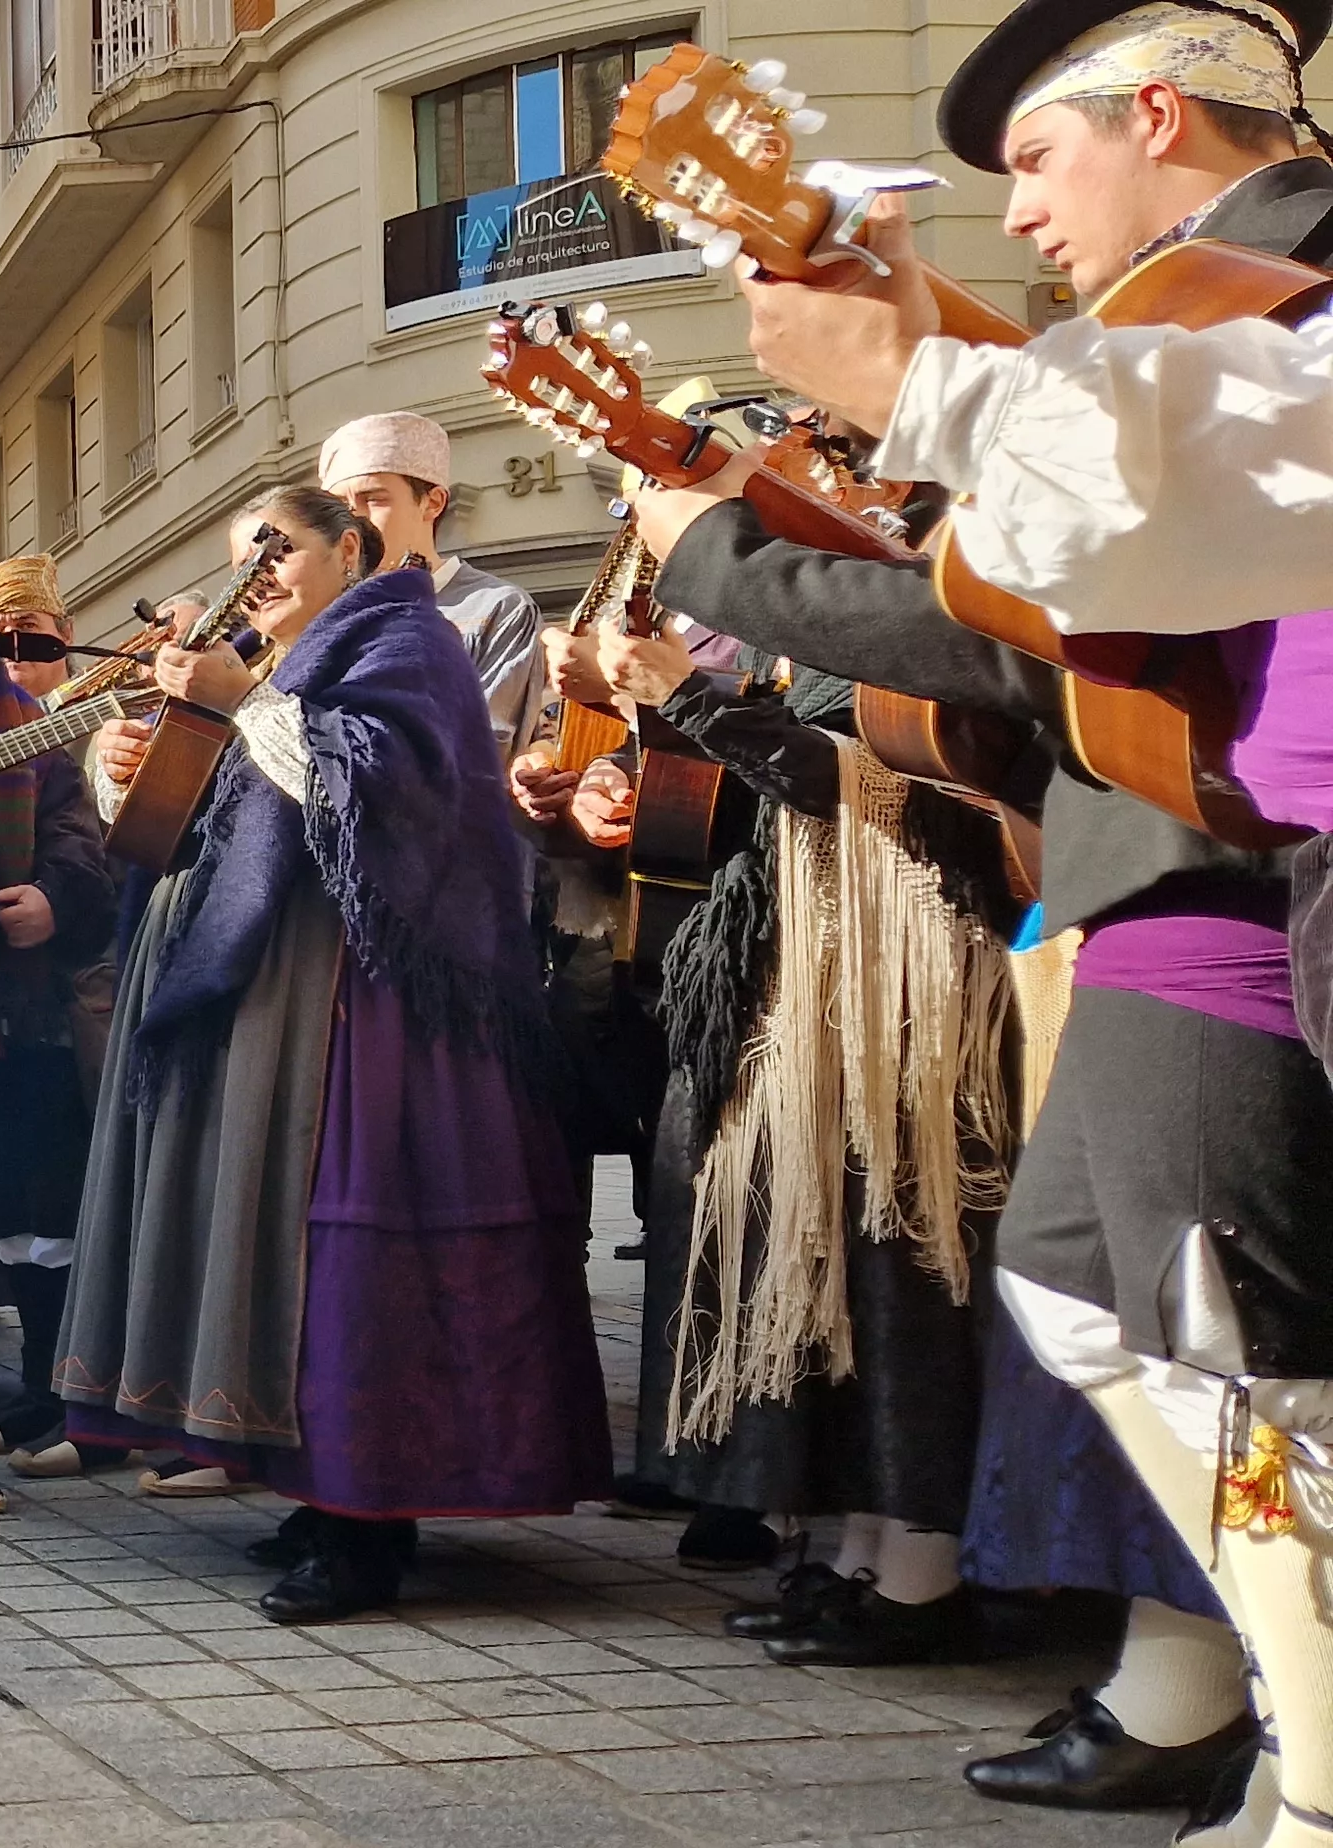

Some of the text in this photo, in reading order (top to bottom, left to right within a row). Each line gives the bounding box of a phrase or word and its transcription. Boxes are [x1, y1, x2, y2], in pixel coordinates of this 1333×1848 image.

[458, 241, 610, 279] Estudio de arquitectura
[503, 450, 563, 498] 31
